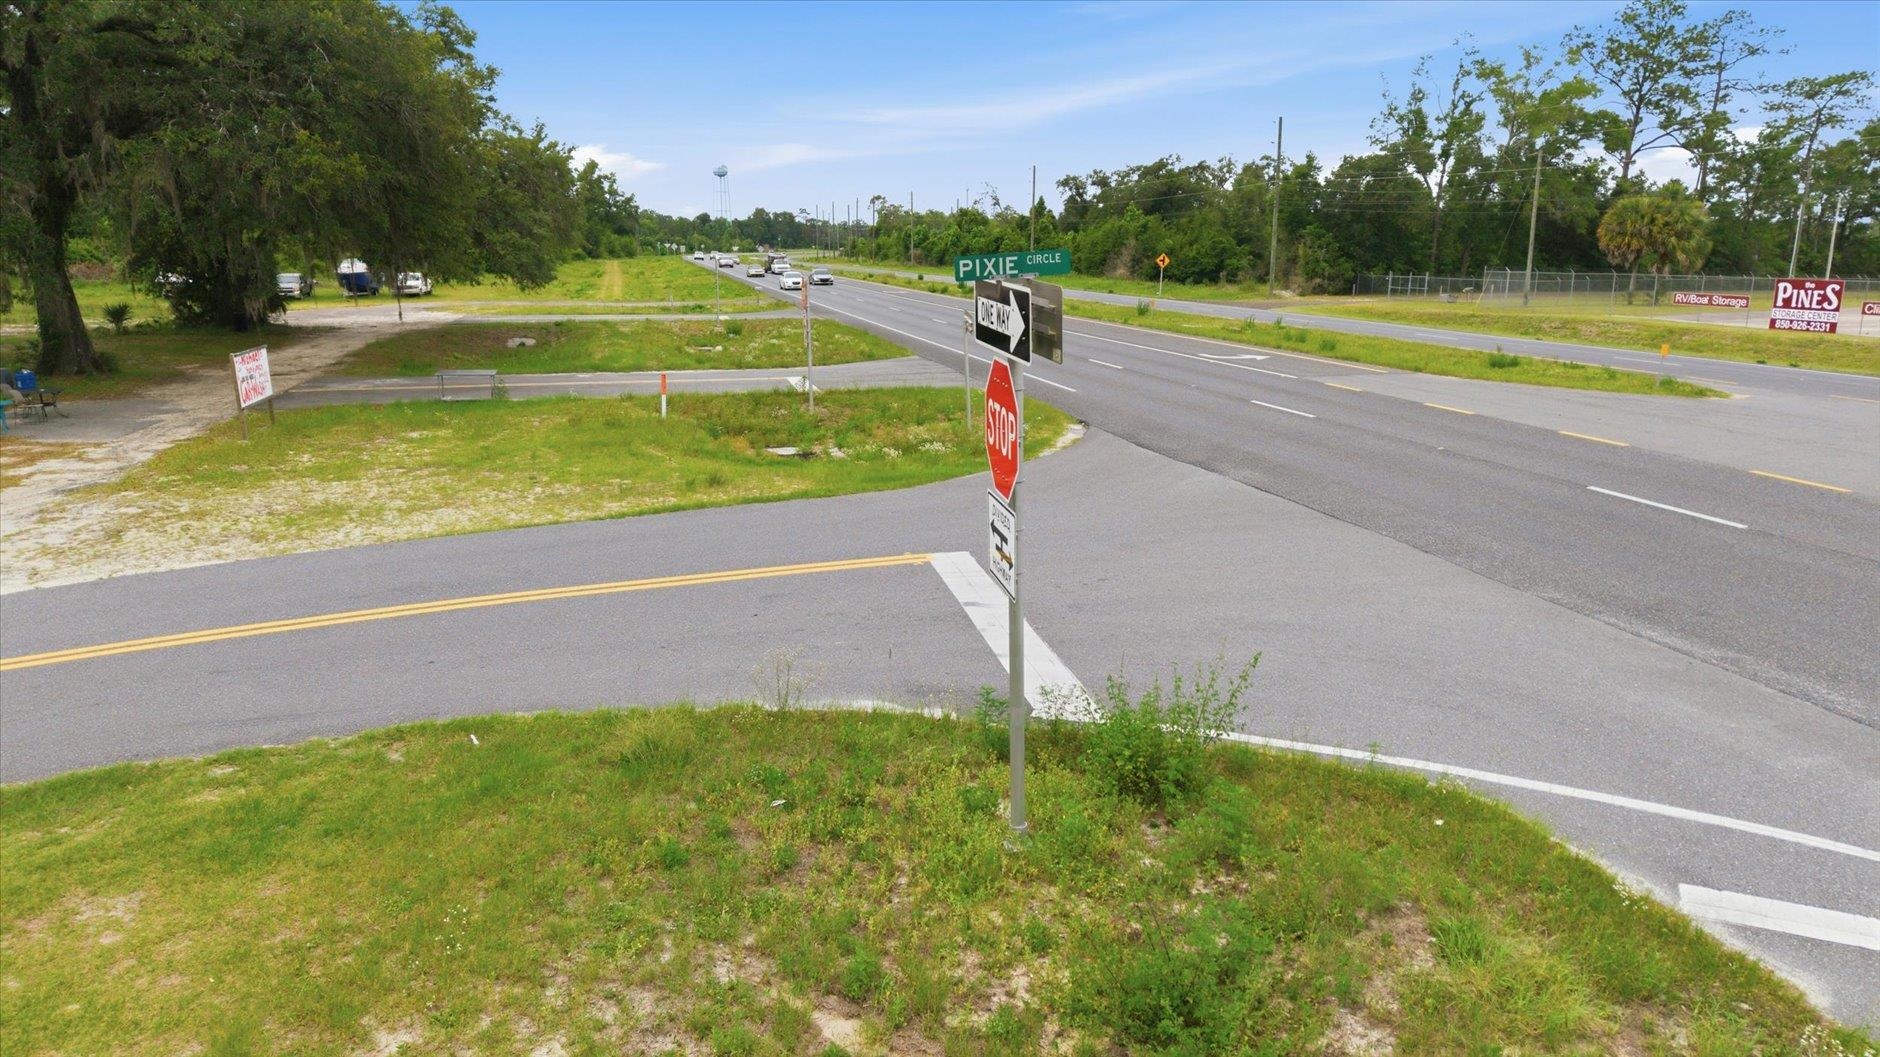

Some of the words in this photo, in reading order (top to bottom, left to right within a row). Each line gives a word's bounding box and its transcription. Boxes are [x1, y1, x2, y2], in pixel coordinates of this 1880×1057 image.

[959, 256, 1019, 278] PIXIE
[1026, 253, 1061, 265] CIRCLE
[1675, 293, 1710, 304] RV/Boat
[1712, 295, 1748, 308] Storage
[1777, 282, 1841, 310] PINES
[981, 301, 994, 327] ONE
[996, 303, 1011, 333] WAY
[1773, 309, 1805, 319] STORAGE
[1807, 311, 1838, 321] CENTER
[1864, 303, 1880, 314] Cli
[1774, 319, 1831, 332] 850-926-2331
[987, 398, 1016, 460] STOP
